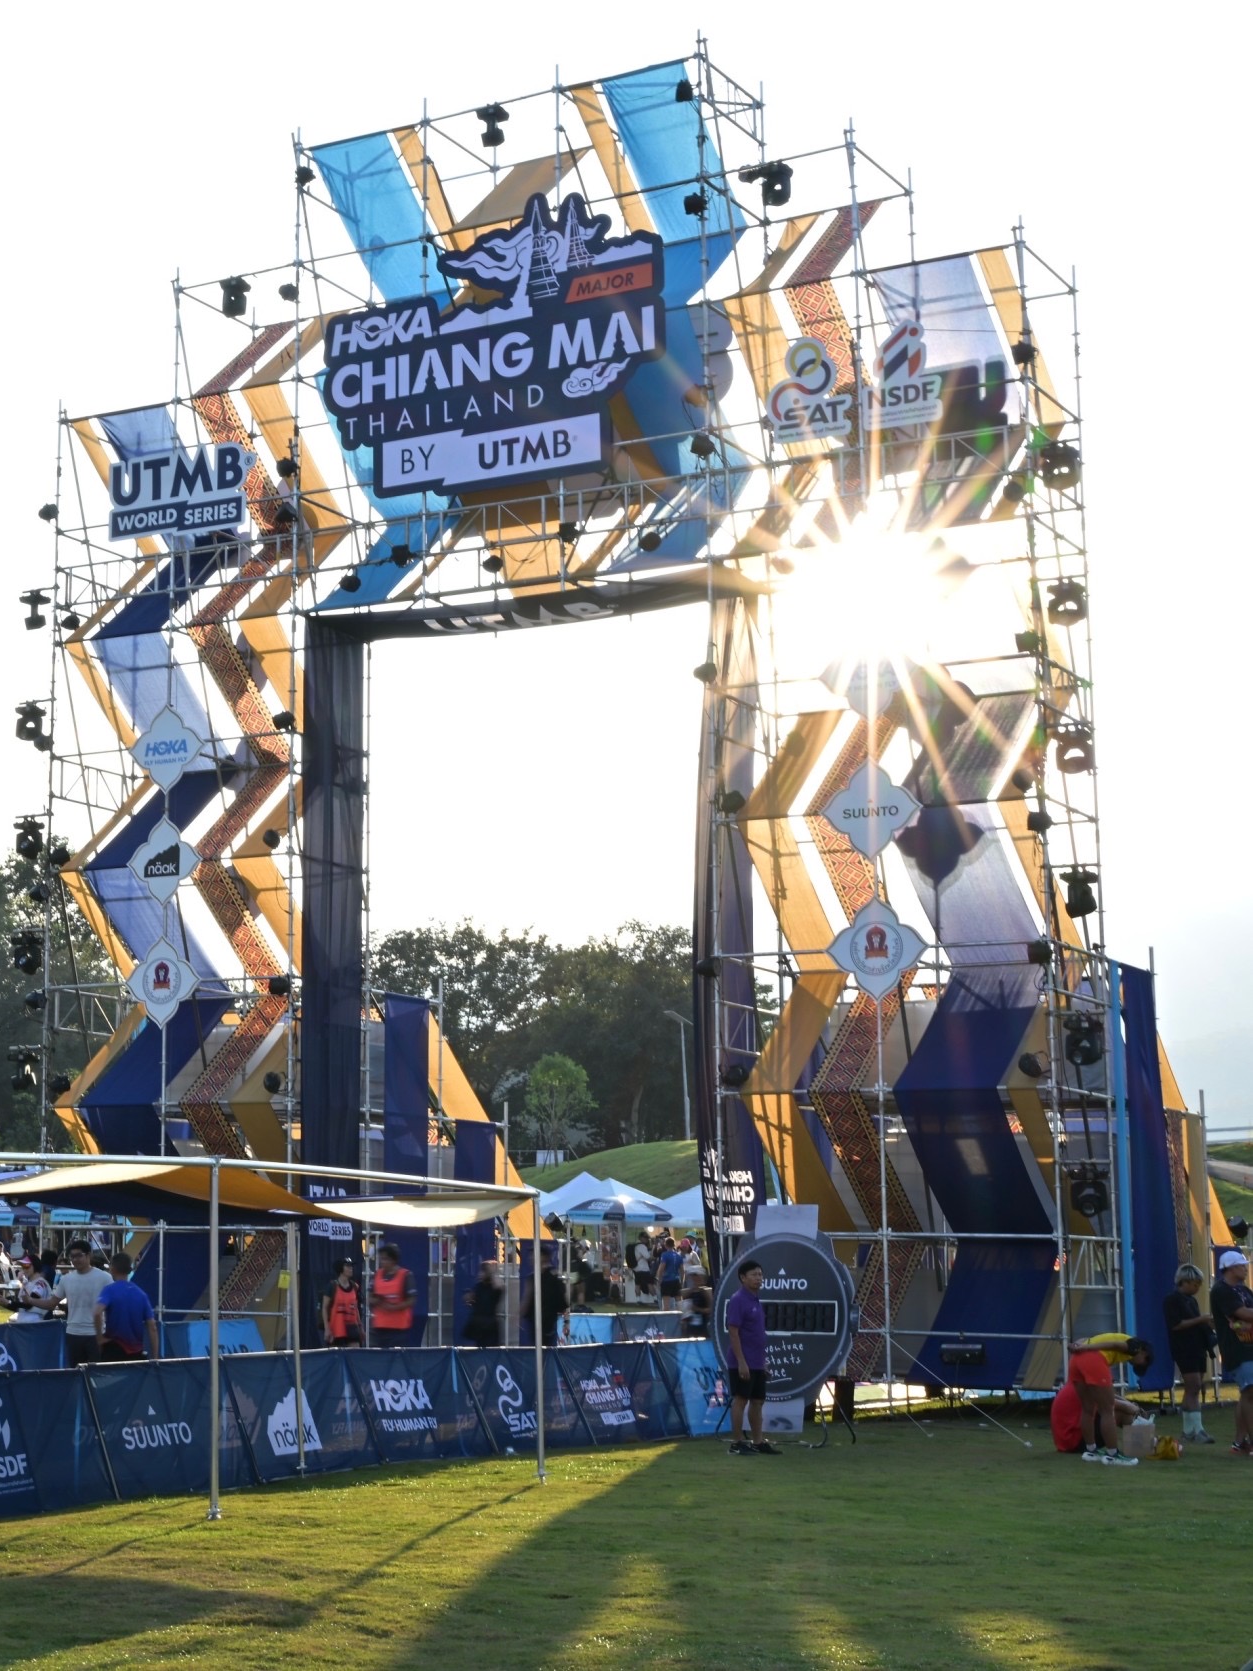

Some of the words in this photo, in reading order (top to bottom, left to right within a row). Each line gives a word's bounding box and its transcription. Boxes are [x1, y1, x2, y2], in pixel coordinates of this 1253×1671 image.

[576, 271, 634, 297] MAJOR
[330, 306, 433, 357] HOKA
[330, 331, 534, 408] CHIANG
[547, 305, 656, 369] MAI
[867, 380, 936, 410] NSDF
[345, 384, 544, 440] THAILAND
[779, 399, 847, 430] SAT
[400, 443, 436, 474] BY
[477, 429, 572, 470] UTMB
[112, 446, 244, 507] UTMB
[117, 508, 177, 531] WORLD
[183, 502, 238, 525] SERIES
[423, 601, 614, 633] UTMB
[144, 738, 188, 757] HOKA
[842, 805, 899, 819] SUUNTO
[147, 861, 176, 875] näak
[331, 1225, 352, 1237] SERIES
[759, 1278, 808, 1291] SUUNTO
[370, 1379, 433, 1412] HOKA
[122, 1421, 192, 1450] SUUNTO
[273, 1422, 317, 1448] näk
[394, 1417, 428, 1432] HUMAN
[508, 1411, 538, 1433] SAT
